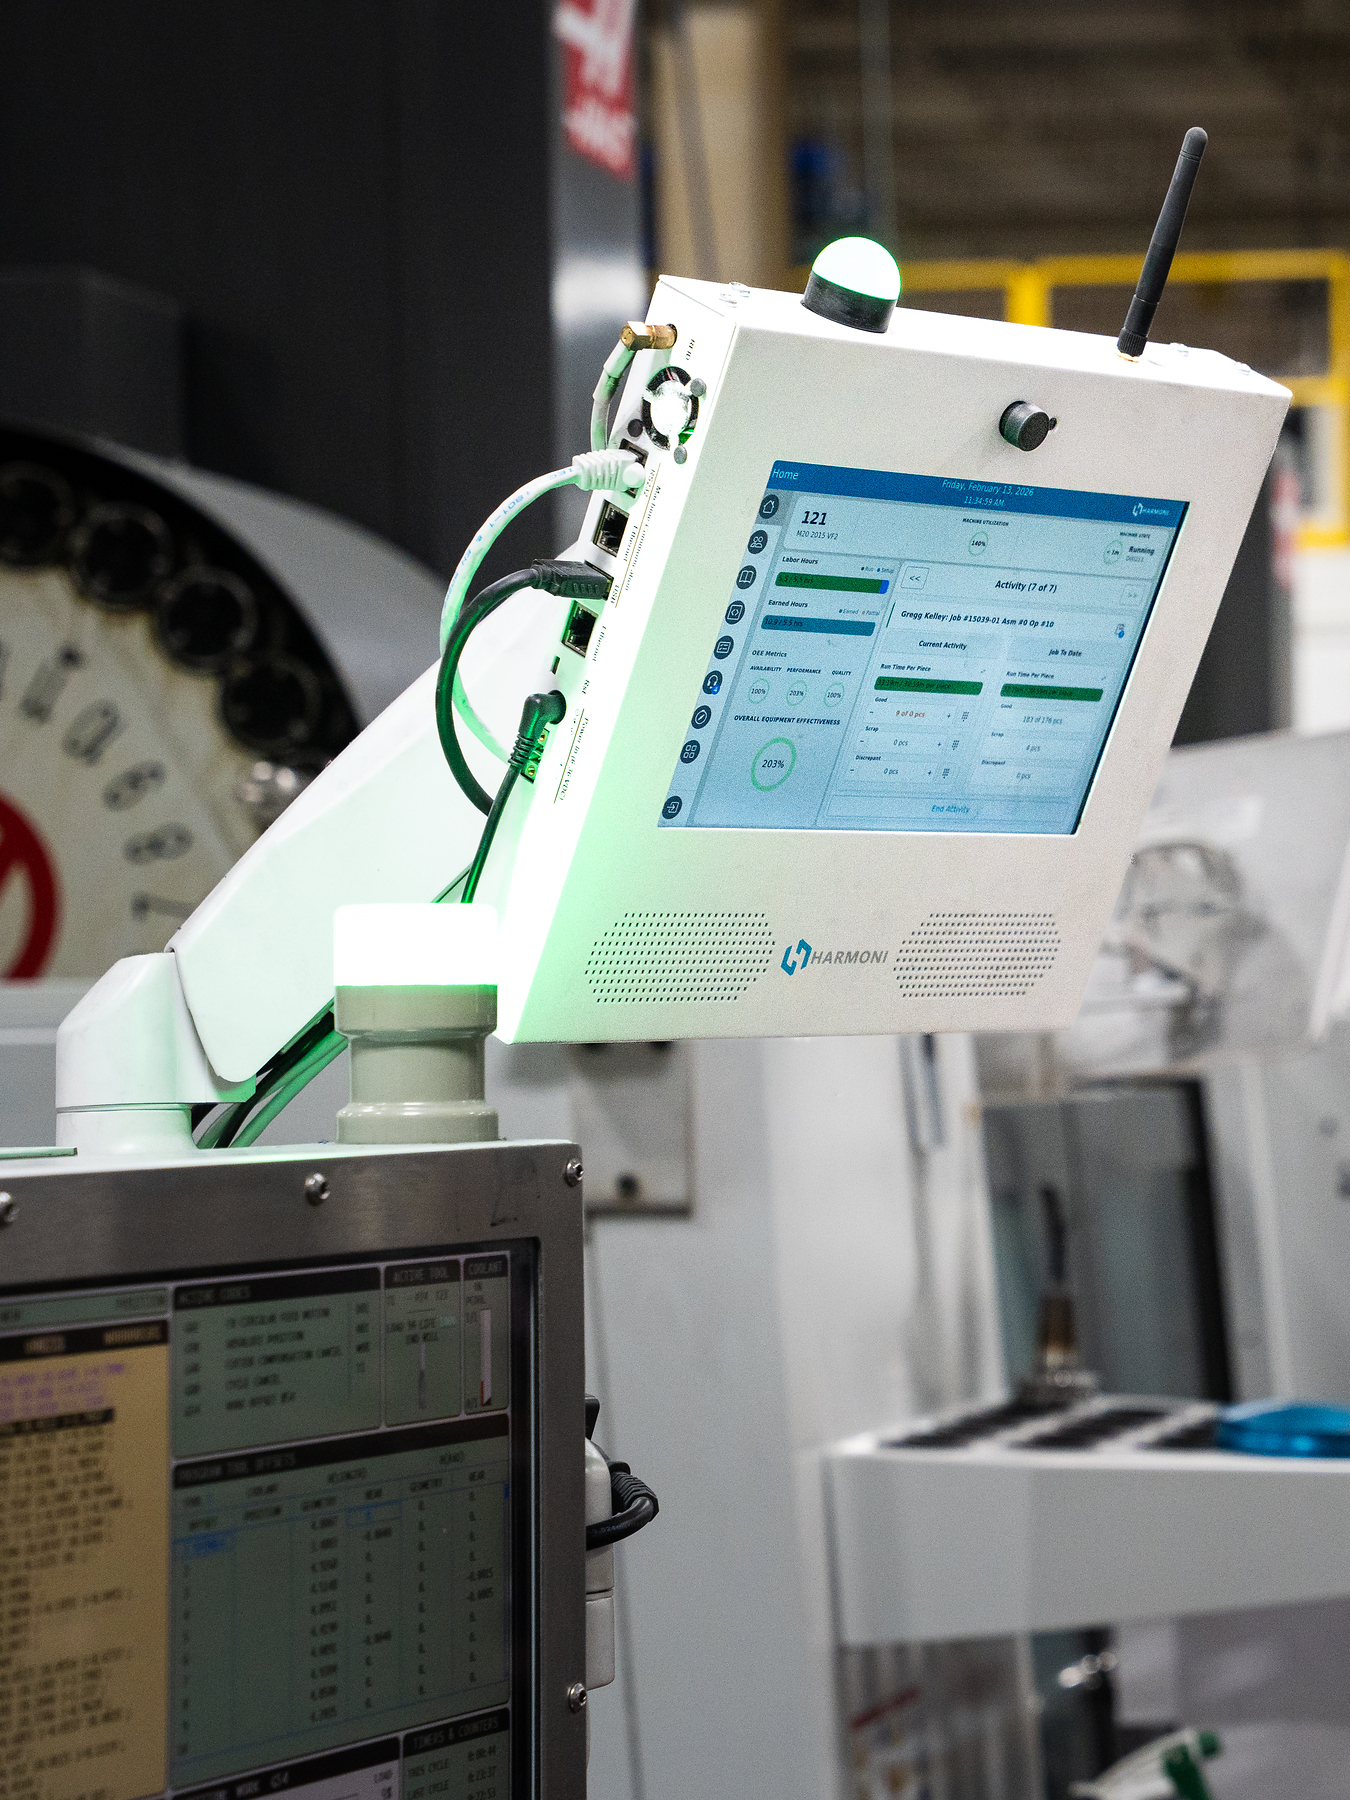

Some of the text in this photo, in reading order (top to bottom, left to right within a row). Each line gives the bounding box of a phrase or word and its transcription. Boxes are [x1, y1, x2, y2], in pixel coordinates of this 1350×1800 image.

[772, 468, 799, 480] Home
[942, 479, 1035, 497] Friday, February 13, 2026
[964, 496, 1005, 507] 11:34:59 AM
[801, 510, 828, 526] 121
[796, 530, 839, 541] M20 2015 VF2
[1128, 546, 1155, 557] Running
[782, 556, 819, 566] Labor Hours
[994, 580, 1058, 594] Activity (7 of 7)
[768, 599, 809, 609] Earned Hours
[900, 610, 1055, 629] Gregg Kelley: Job #15039-01 Asm #0 Op #10
[918, 640, 968, 651] Current Activity
[765, 650, 788, 658] Metrics
[1048, 649, 1082, 658] Job To Date
[786, 667, 822, 675] PERFORMANCE
[761, 716, 795, 724] EQUIPMENT
[796, 717, 841, 726] EFFECTIVENESS
[762, 759, 785, 769] 203%
[931, 804, 970, 814] End Activity
[810, 950, 889, 965] HARMONI
[468, 1260, 503, 1276] COOLANT
[458, 1716, 499, 1738] COUNTERS
